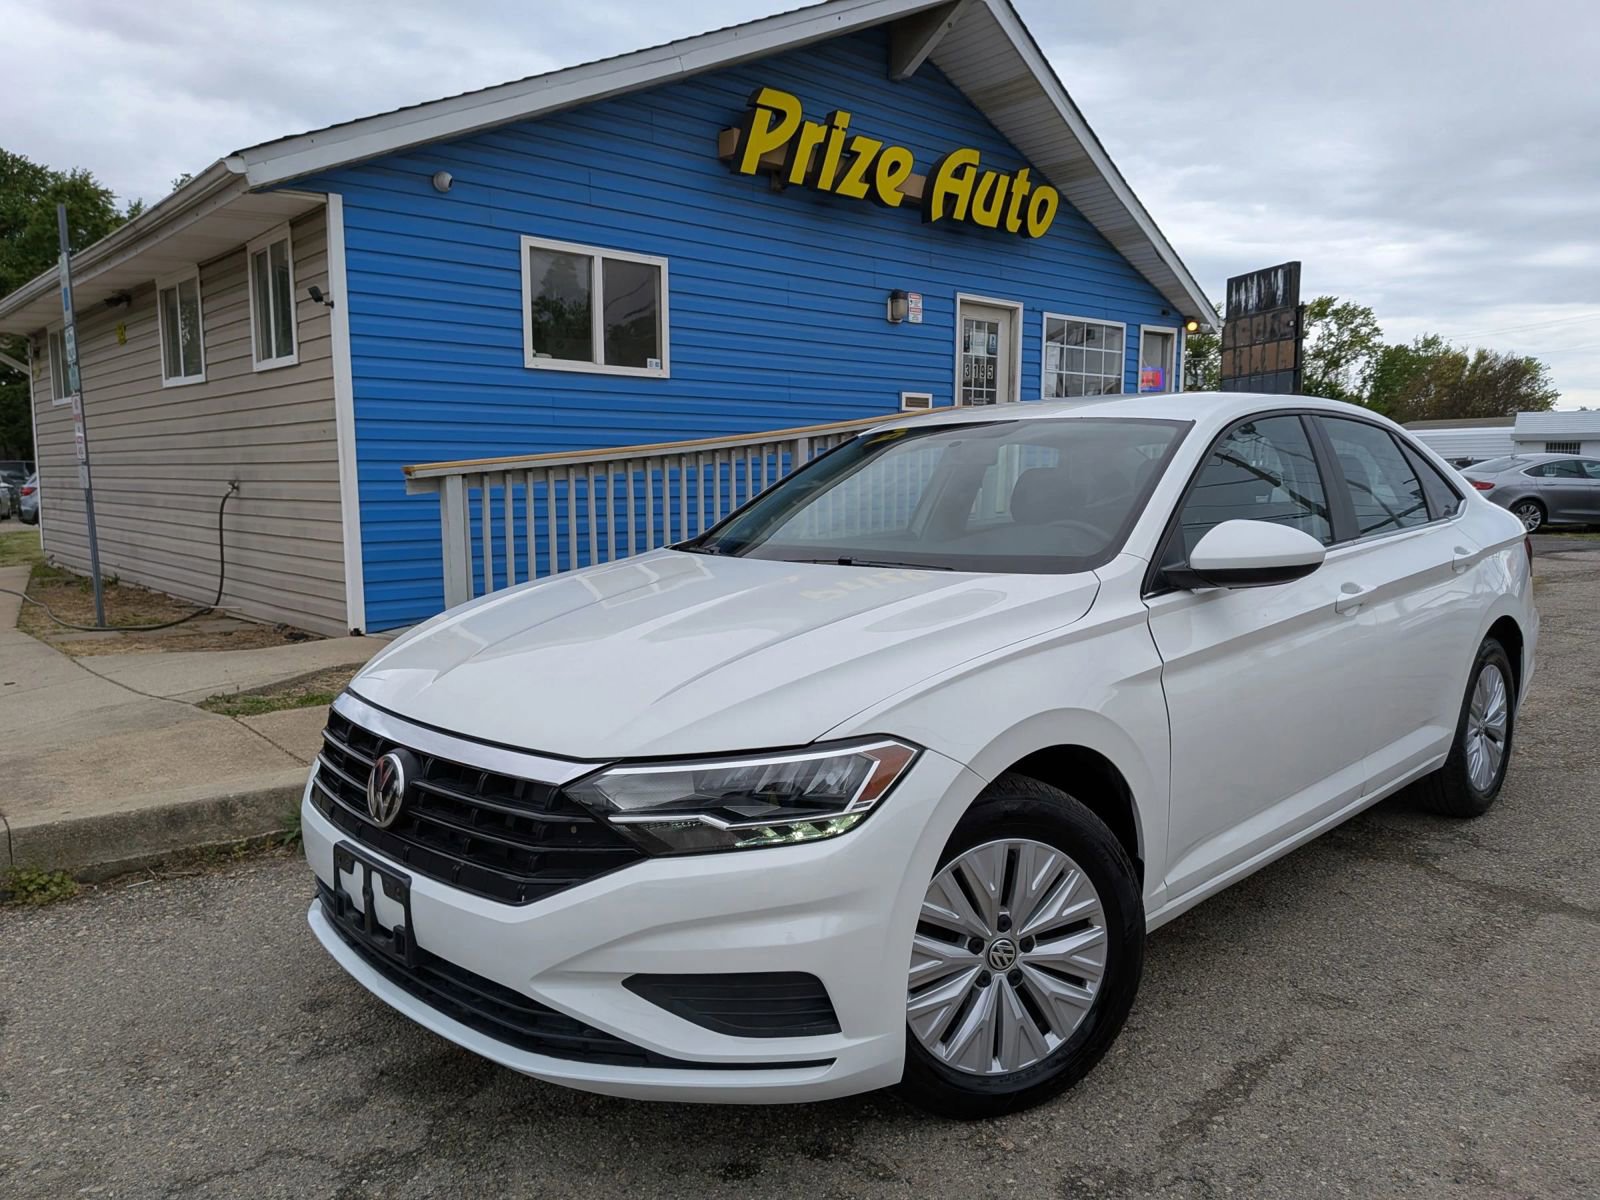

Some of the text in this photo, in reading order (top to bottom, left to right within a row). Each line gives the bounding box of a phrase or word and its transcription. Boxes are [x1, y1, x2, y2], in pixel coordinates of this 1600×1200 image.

[740, 87, 1059, 239] Prize Auto
[965, 364, 993, 379] 3195
